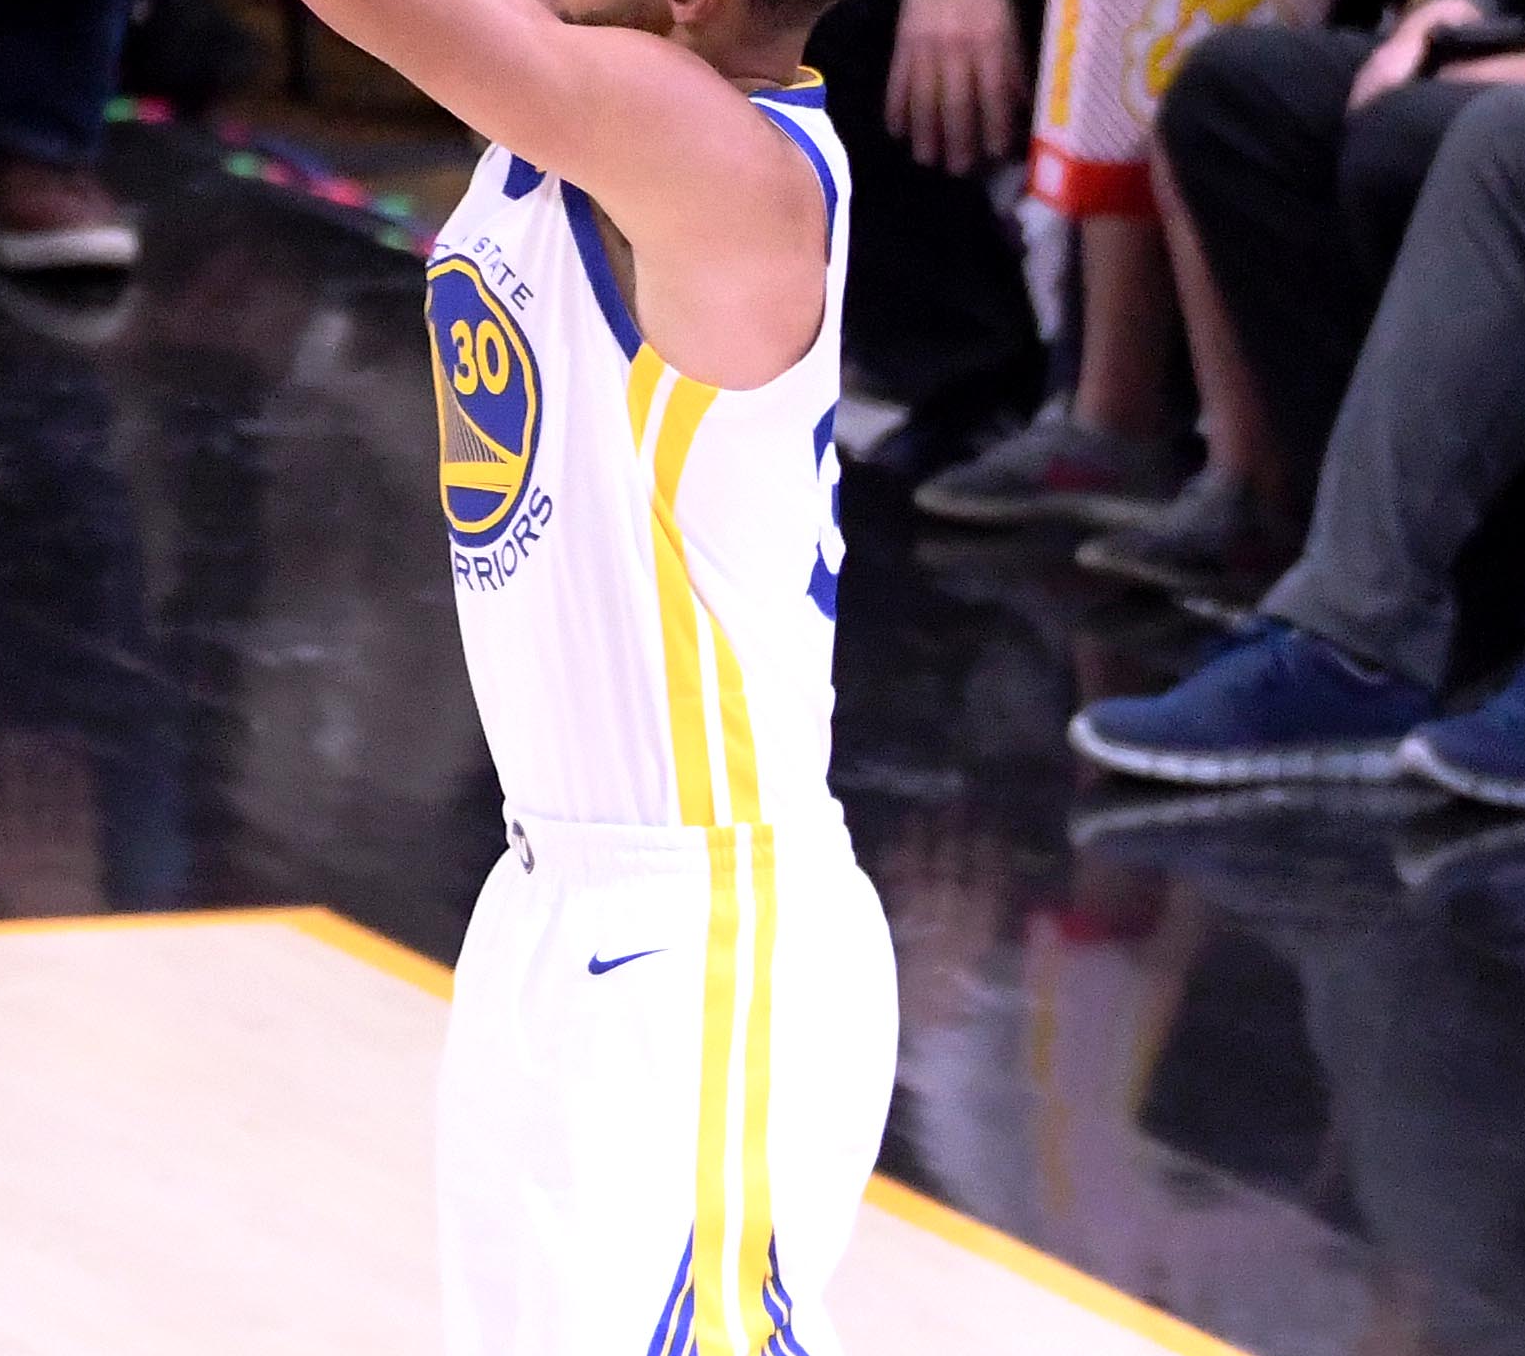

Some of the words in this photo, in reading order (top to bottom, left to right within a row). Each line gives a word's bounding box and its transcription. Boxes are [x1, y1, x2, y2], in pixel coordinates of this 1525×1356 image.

[472, 236, 534, 311] STATE
[450, 319, 510, 395] 30
[453, 486, 553, 592] RRIORS
